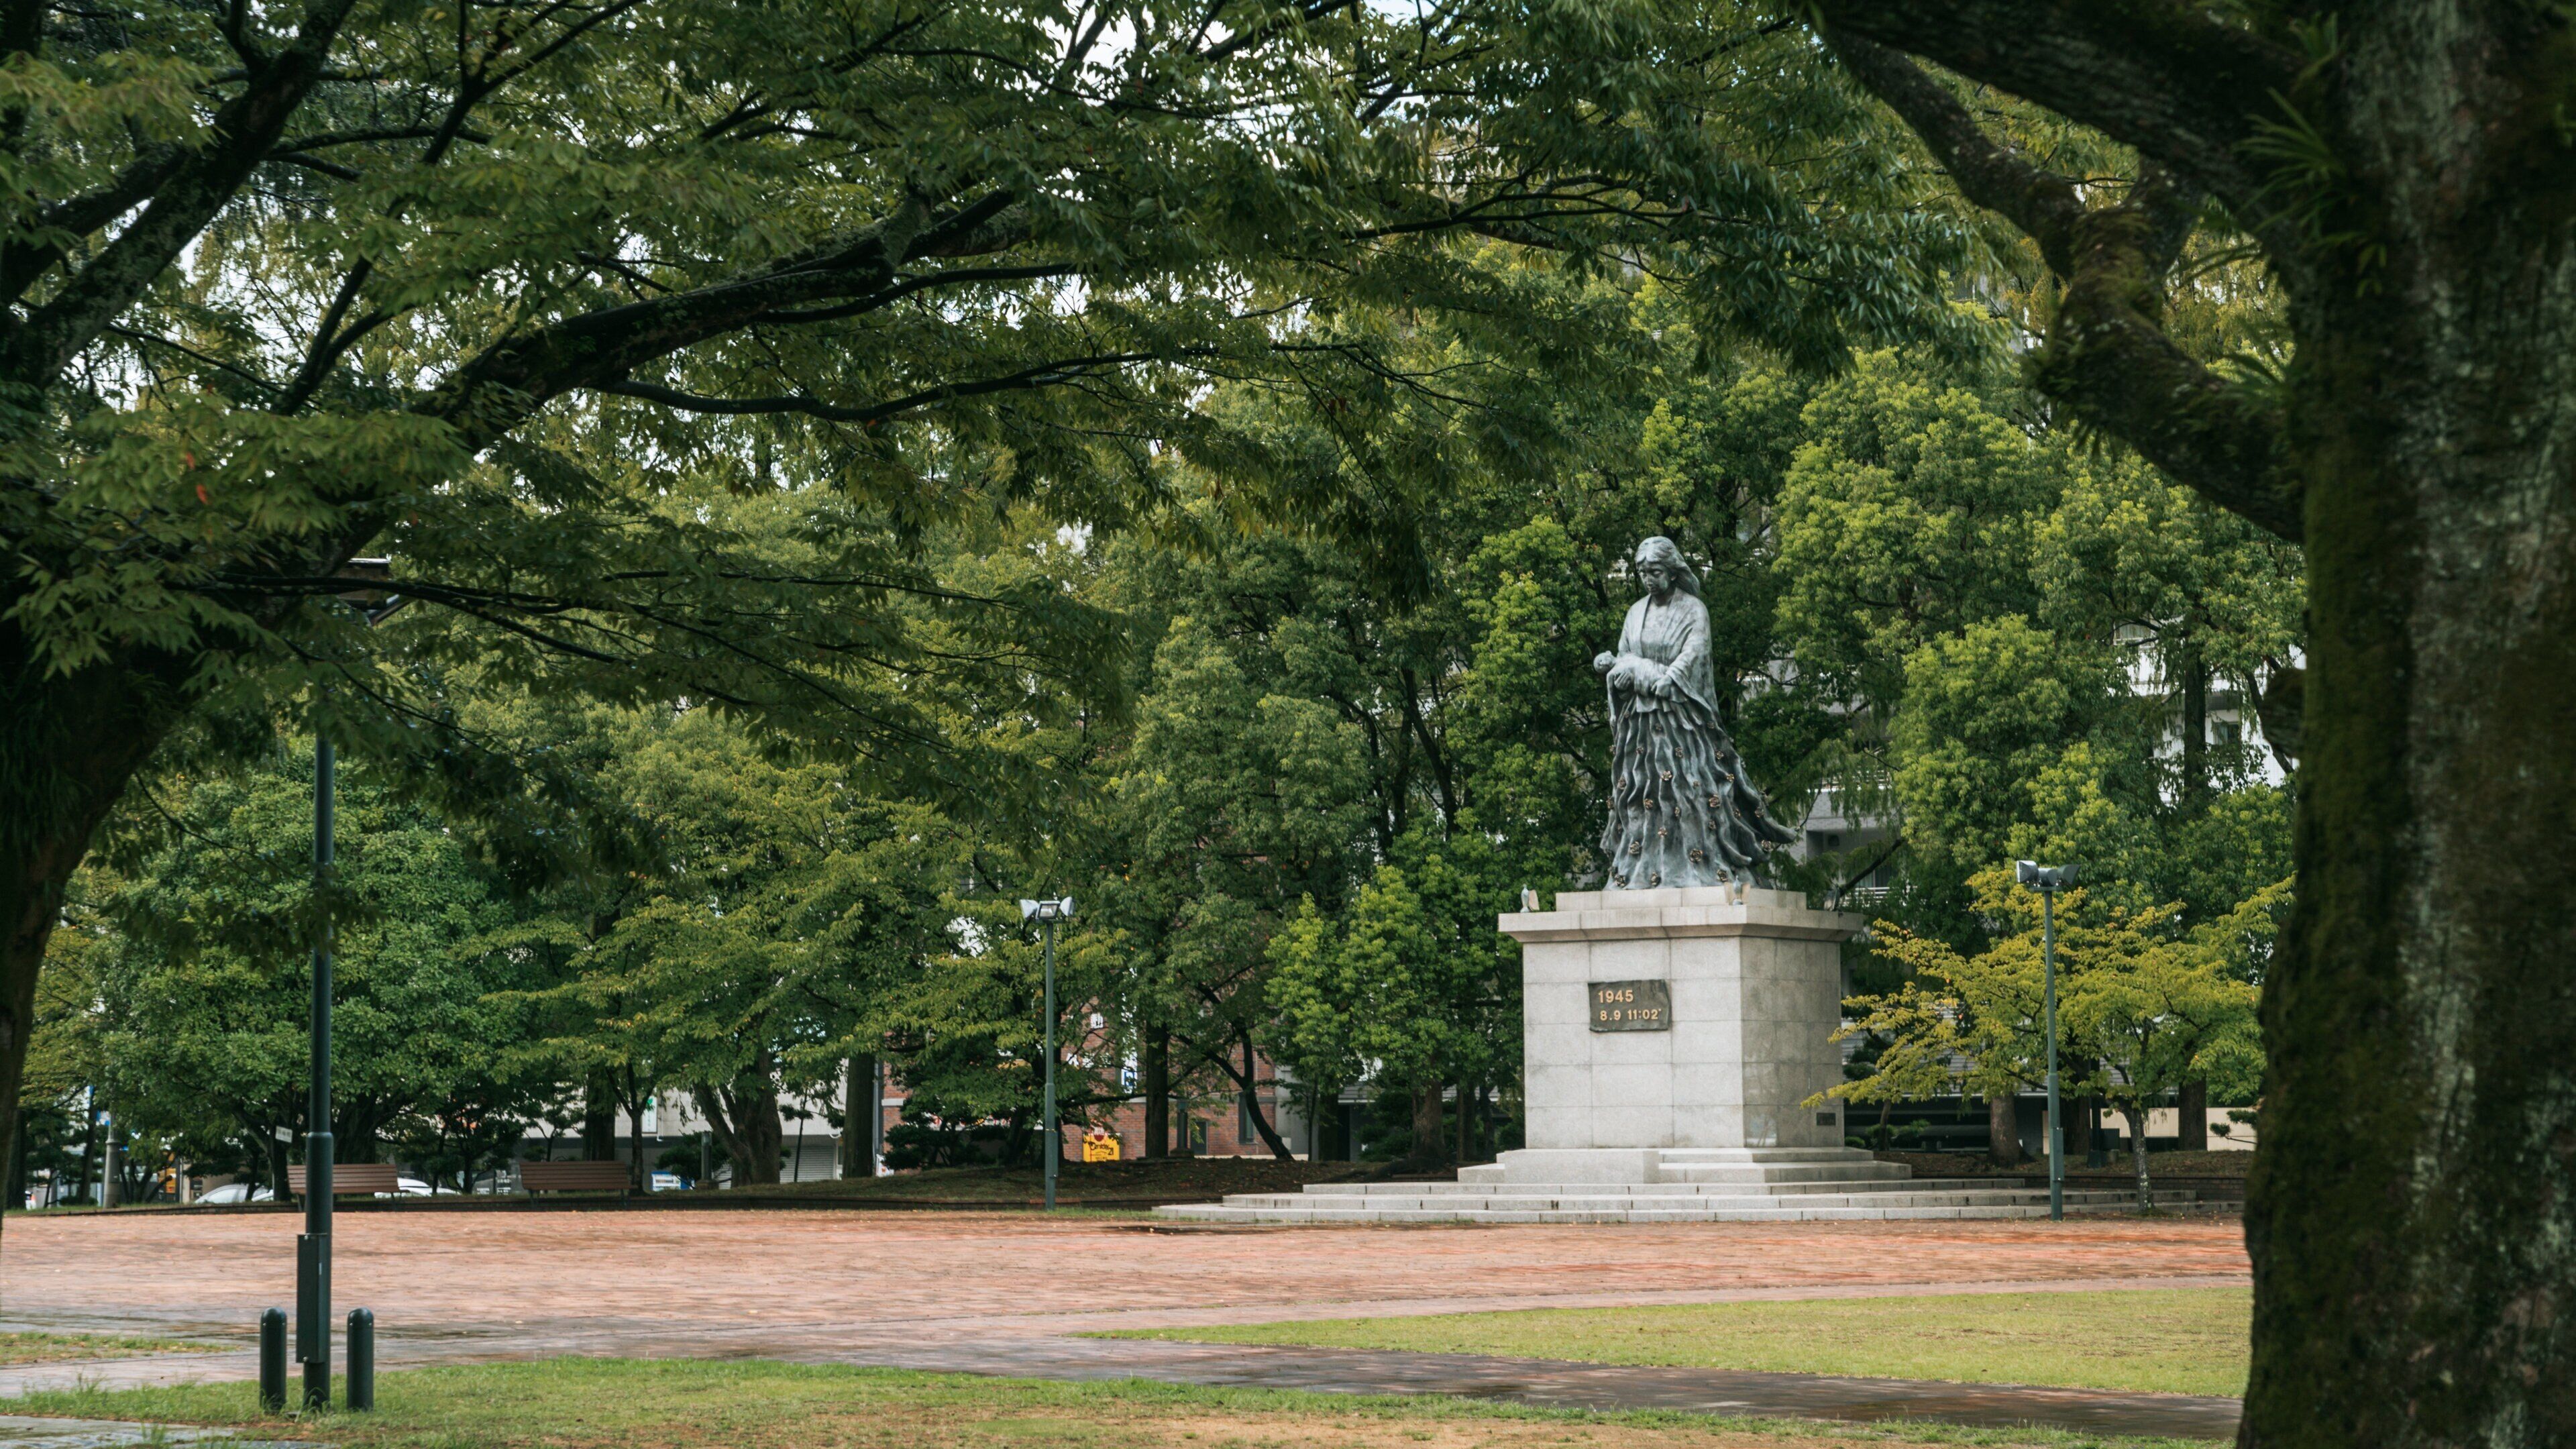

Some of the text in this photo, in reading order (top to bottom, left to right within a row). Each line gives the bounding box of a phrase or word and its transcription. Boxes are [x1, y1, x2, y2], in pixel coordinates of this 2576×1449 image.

[1598, 989, 1634, 1003] 1945
[1600, 1009, 1658, 1021] 8.9 11:02
